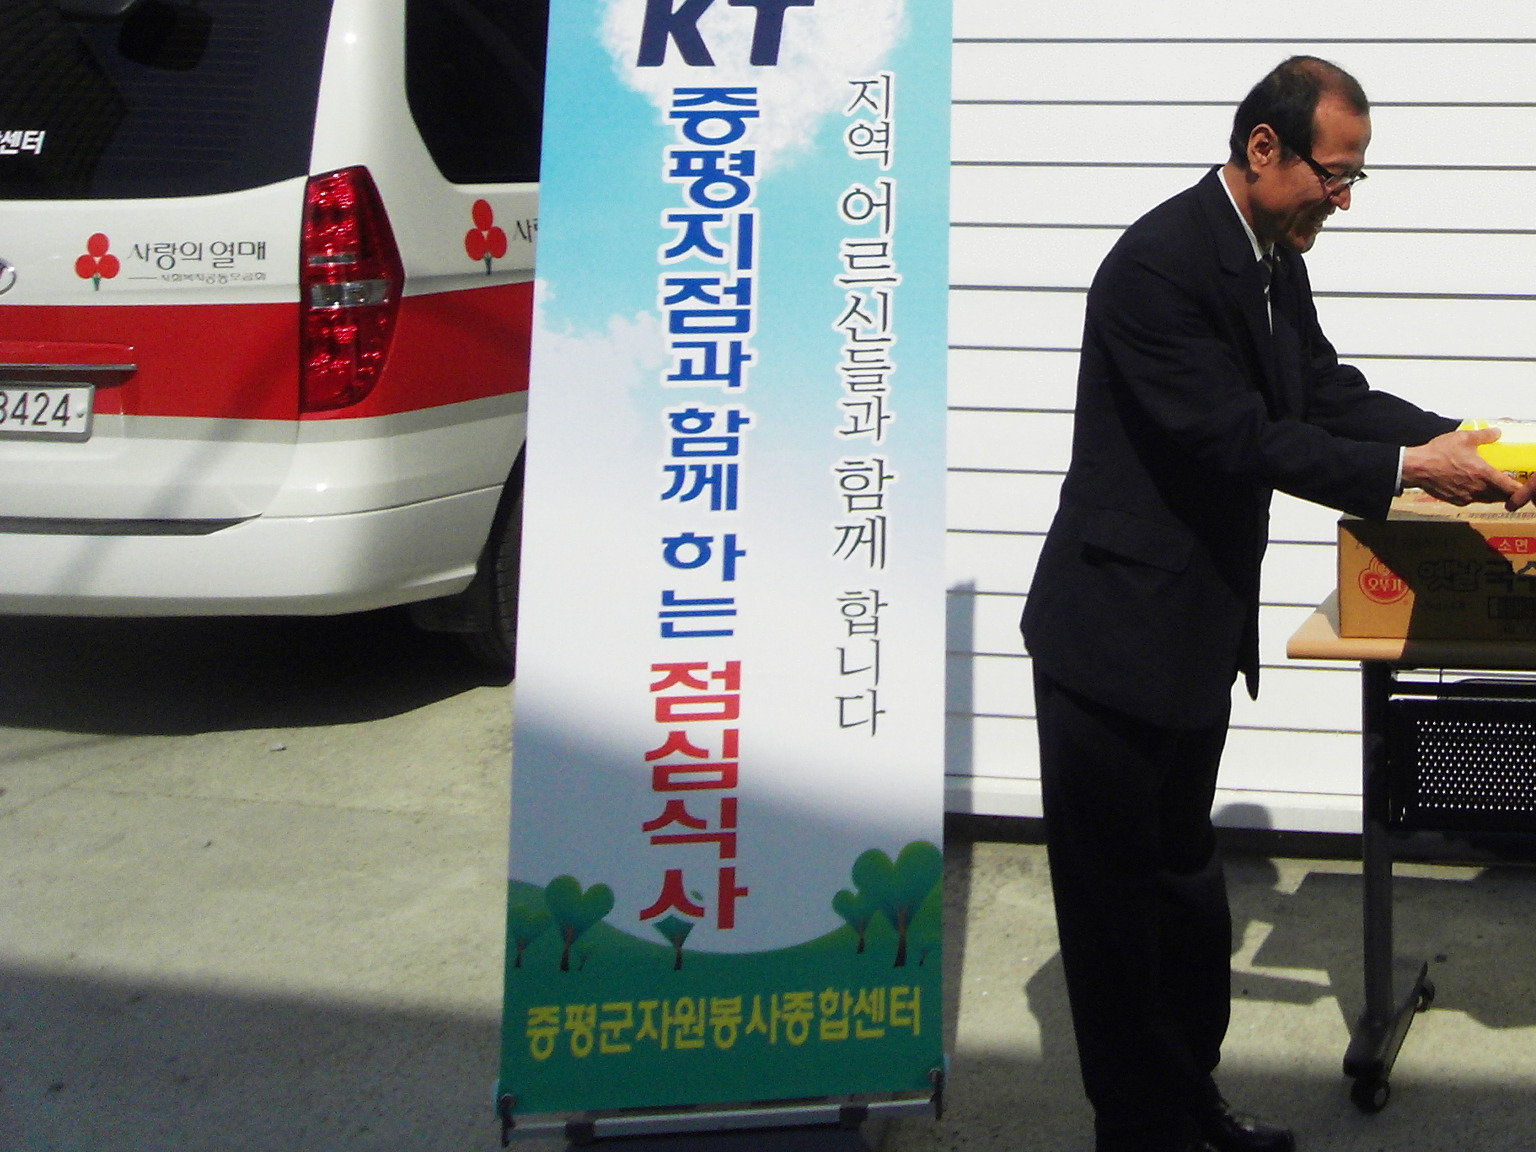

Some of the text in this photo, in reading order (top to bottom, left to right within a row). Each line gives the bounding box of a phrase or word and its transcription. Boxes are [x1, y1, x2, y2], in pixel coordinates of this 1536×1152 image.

[0, 130, 46, 155] 센터
[127, 241, 266, 270] 사랑의 열매
[832, 74, 899, 737] 지역 어르신들과 함께 합니다
[638, 86, 761, 930] 증평지점과 함께 하는 점심식사
[525, 986, 922, 1061] 증평군자원봉사종합센터
